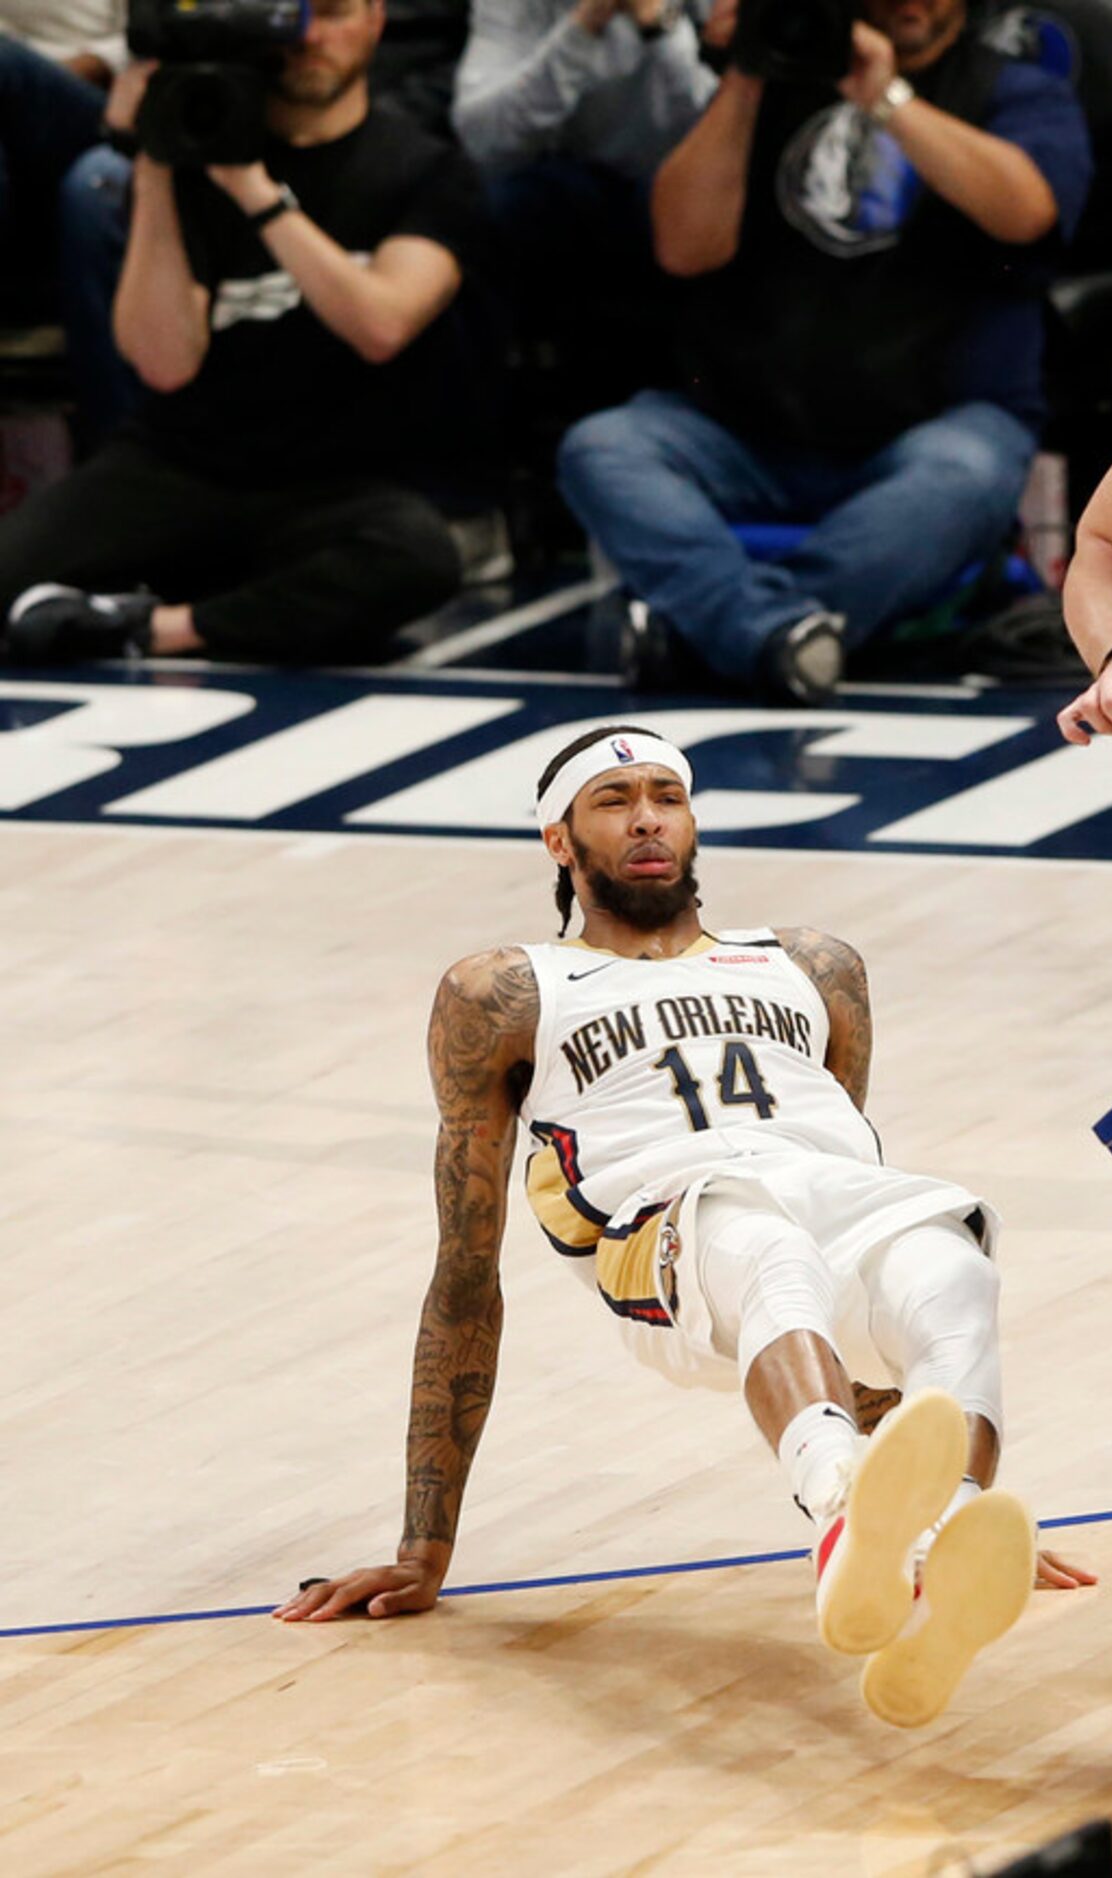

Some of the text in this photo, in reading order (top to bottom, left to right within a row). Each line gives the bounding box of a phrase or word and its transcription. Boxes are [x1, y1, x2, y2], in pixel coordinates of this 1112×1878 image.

[560, 994, 812, 1095] NEW ORLEANS
[653, 1040, 778, 1132] 14
